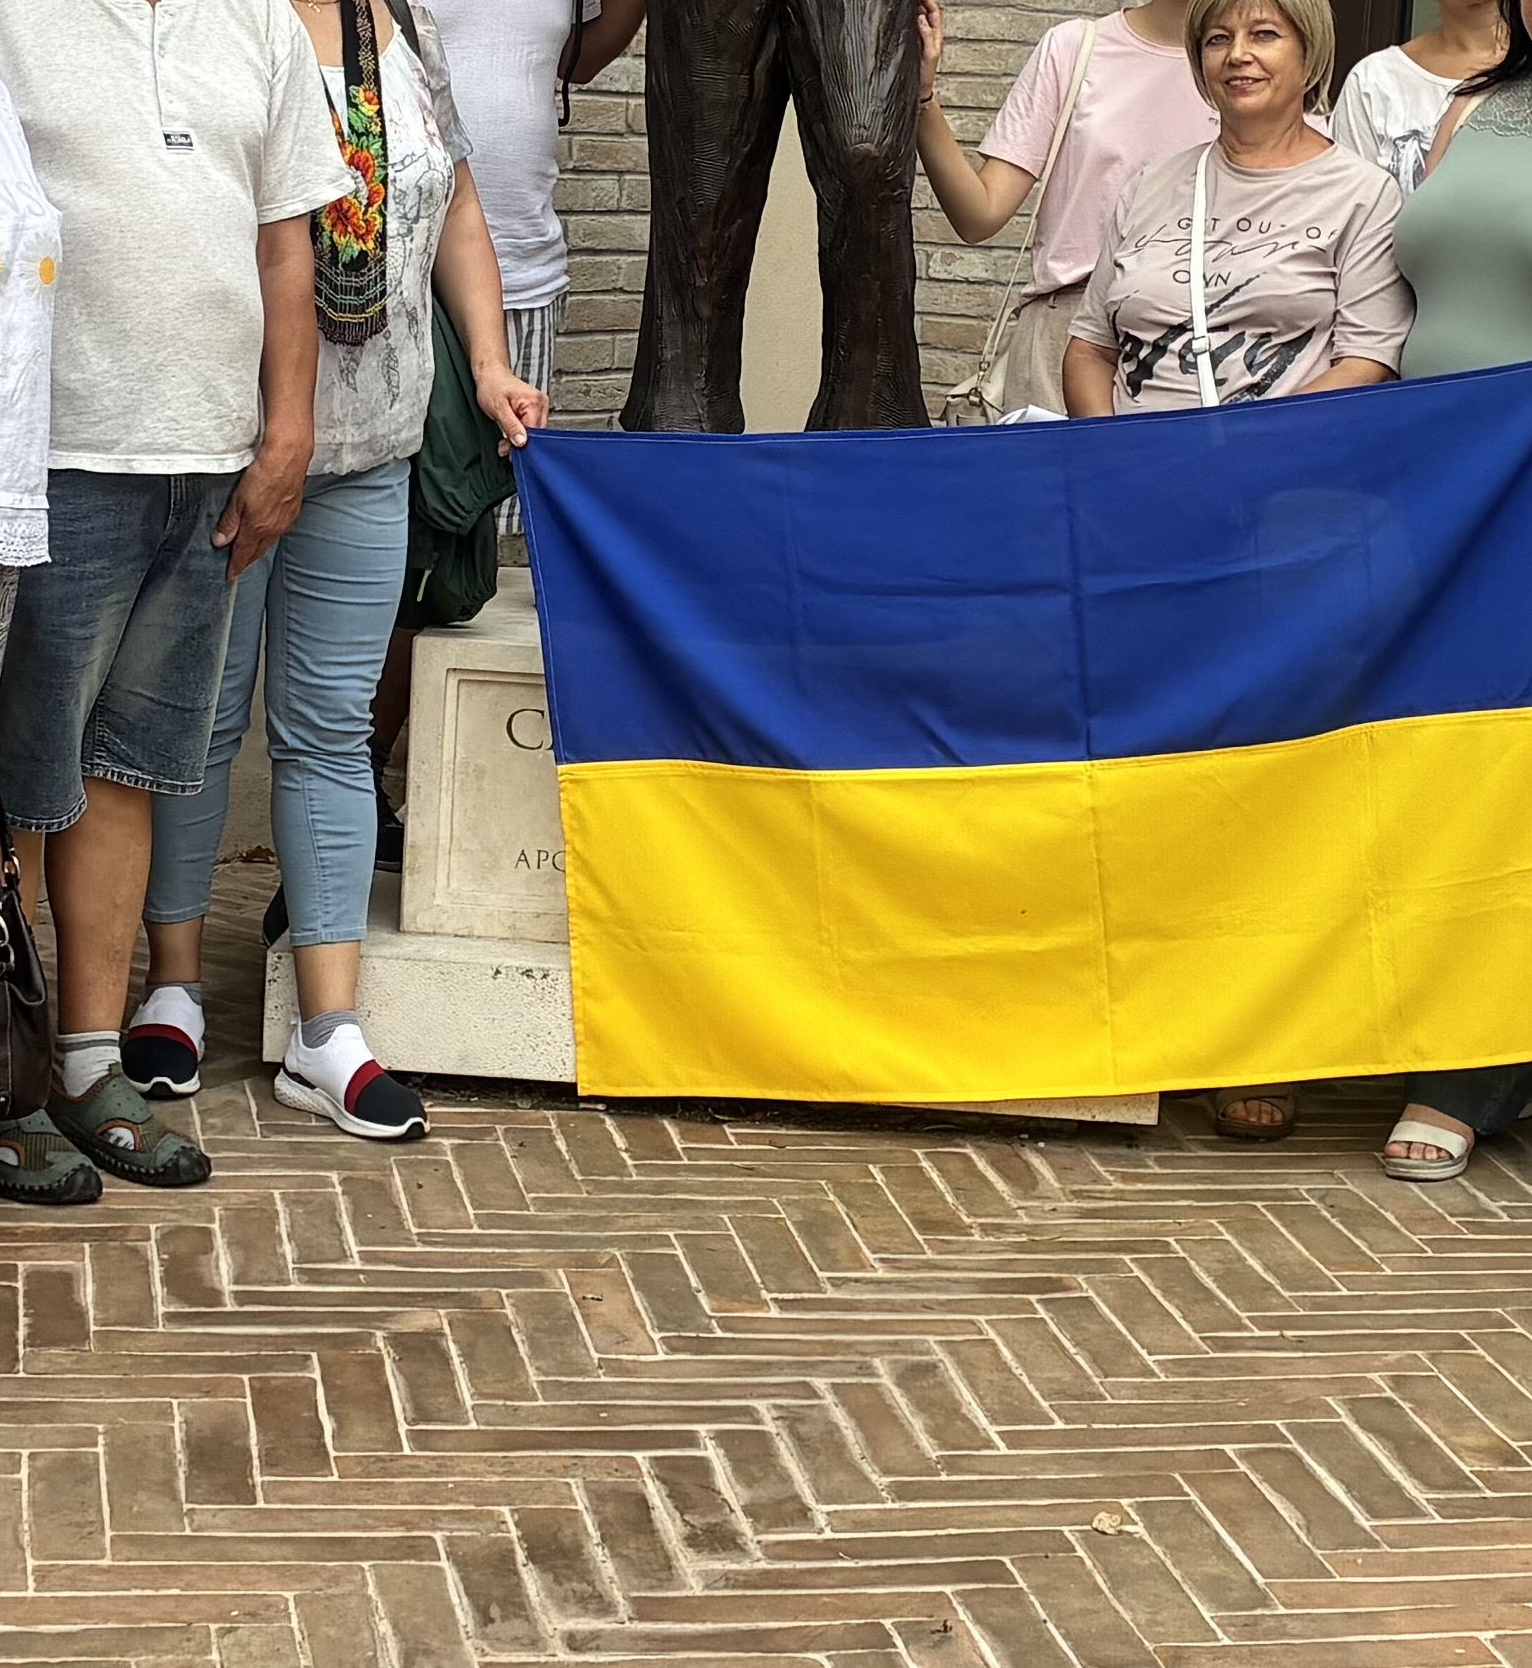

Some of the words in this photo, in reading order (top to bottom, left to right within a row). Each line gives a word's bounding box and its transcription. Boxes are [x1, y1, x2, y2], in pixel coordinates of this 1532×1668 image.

[1177, 217, 1221, 232] GT
[1236, 217, 1286, 234] OU
[506, 708, 554, 751] C
